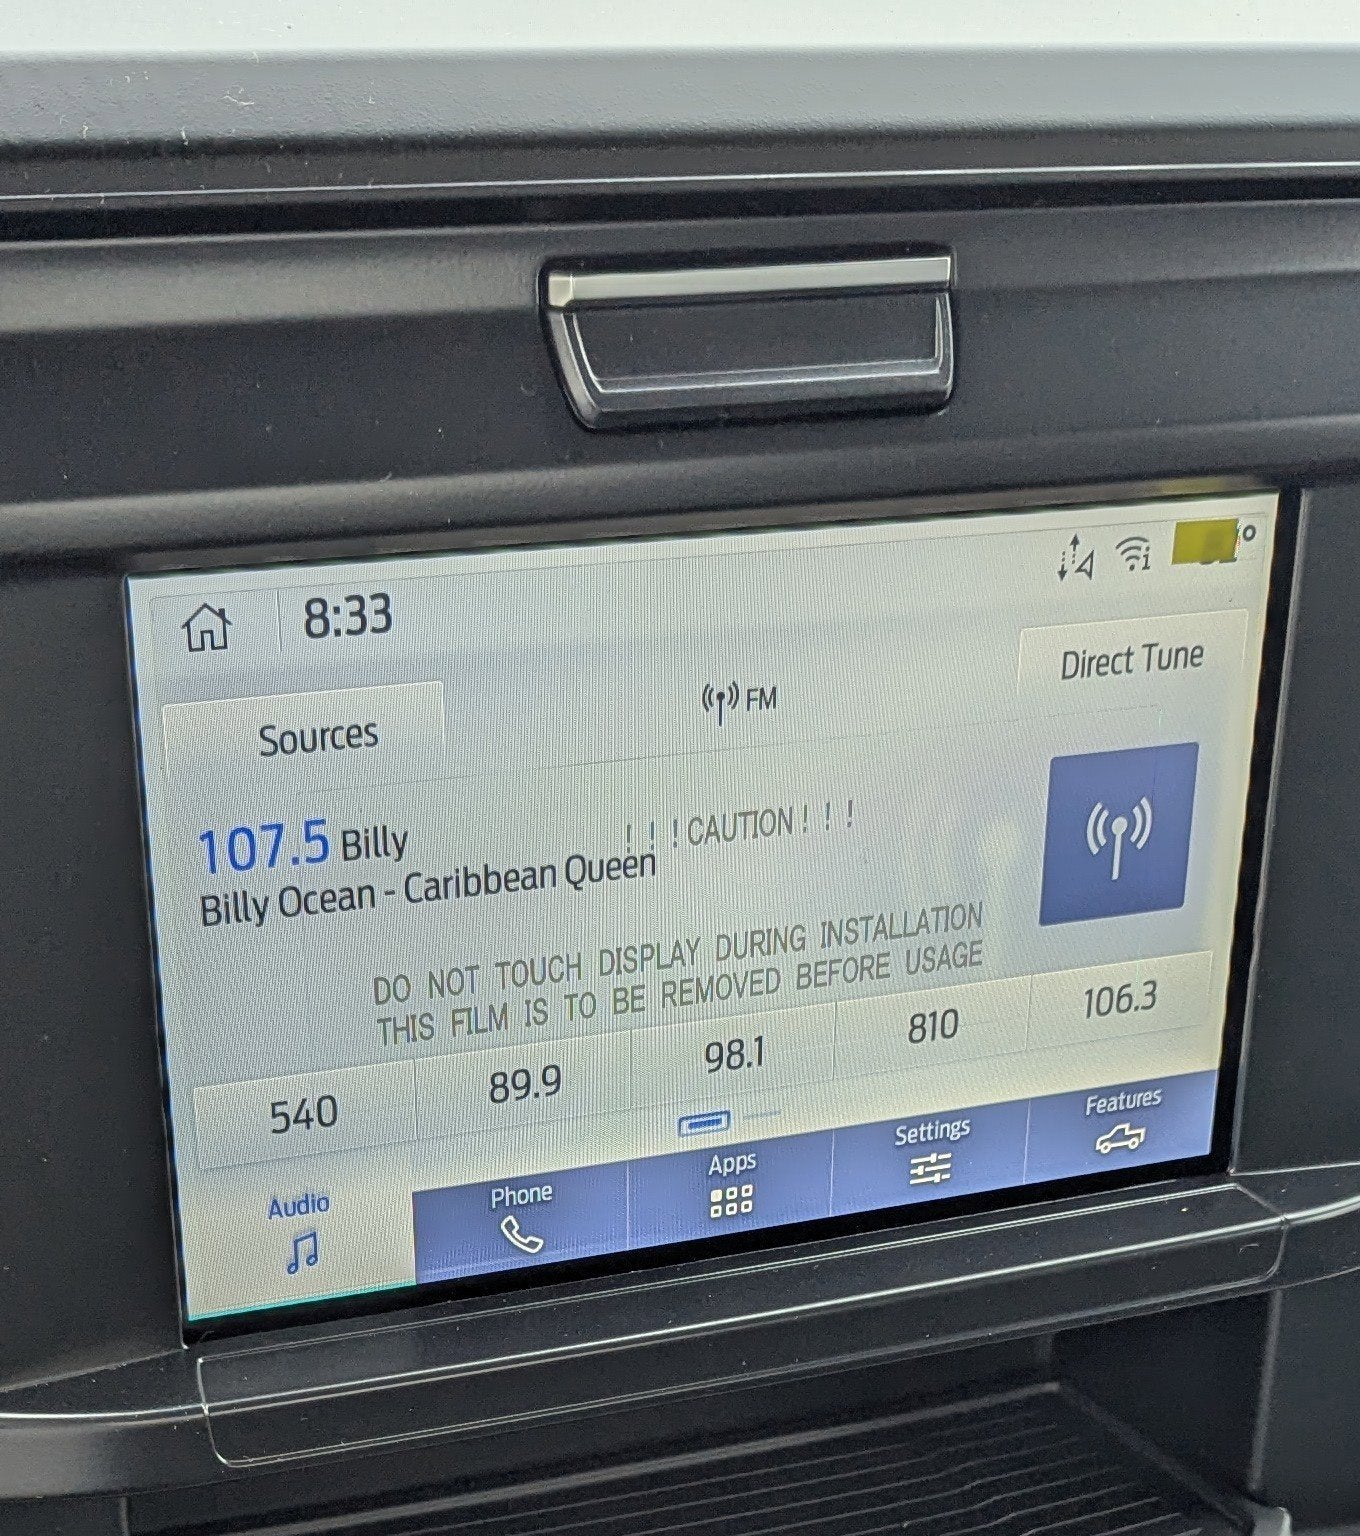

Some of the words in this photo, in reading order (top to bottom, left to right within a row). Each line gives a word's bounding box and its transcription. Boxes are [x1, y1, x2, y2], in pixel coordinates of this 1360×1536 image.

[302, 592, 394, 640] 8:33
[1061, 646, 1135, 681] Direct
[1142, 641, 1206, 671] Tune
[746, 687, 778, 713] FM
[259, 721, 380, 757] Sources
[199, 818, 331, 876] 107.5
[341, 825, 409, 864] Billy
[199, 893, 270, 929] Billy
[278, 882, 377, 919] Ocean
[403, 857, 557, 905] Caribbean
[564, 852, 657, 891] Queen
[372, 974, 412, 1006] DO
[427, 964, 480, 999] NOT
[494, 952, 583, 991] TOUCH
[598, 936, 703, 978] DISPLAY
[715, 922, 807, 964] DURING
[820, 901, 984, 951] INSTALLATION
[377, 1011, 436, 1047] THIS
[451, 1004, 509, 1037] FILM
[524, 997, 550, 1028] IS
[563, 991, 597, 1022] TO
[612, 984, 647, 1016] BE
[660, 965, 781, 1009] REMOVED
[795, 947, 891, 992] BEFORE
[904, 938, 984, 975] USAGE
[1083, 979, 1158, 1020] 106.3
[908, 1007, 960, 1045] 810
[704, 1035, 766, 1074] 98.1
[488, 1064, 563, 1104] 89.9
[1085, 1087, 1163, 1117] Features
[269, 1092, 339, 1136] 540
[894, 1117, 972, 1147] Settings
[708, 1151, 758, 1178] Apps
[266, 1192, 331, 1221] Audio
[491, 1182, 554, 1211] Phone
